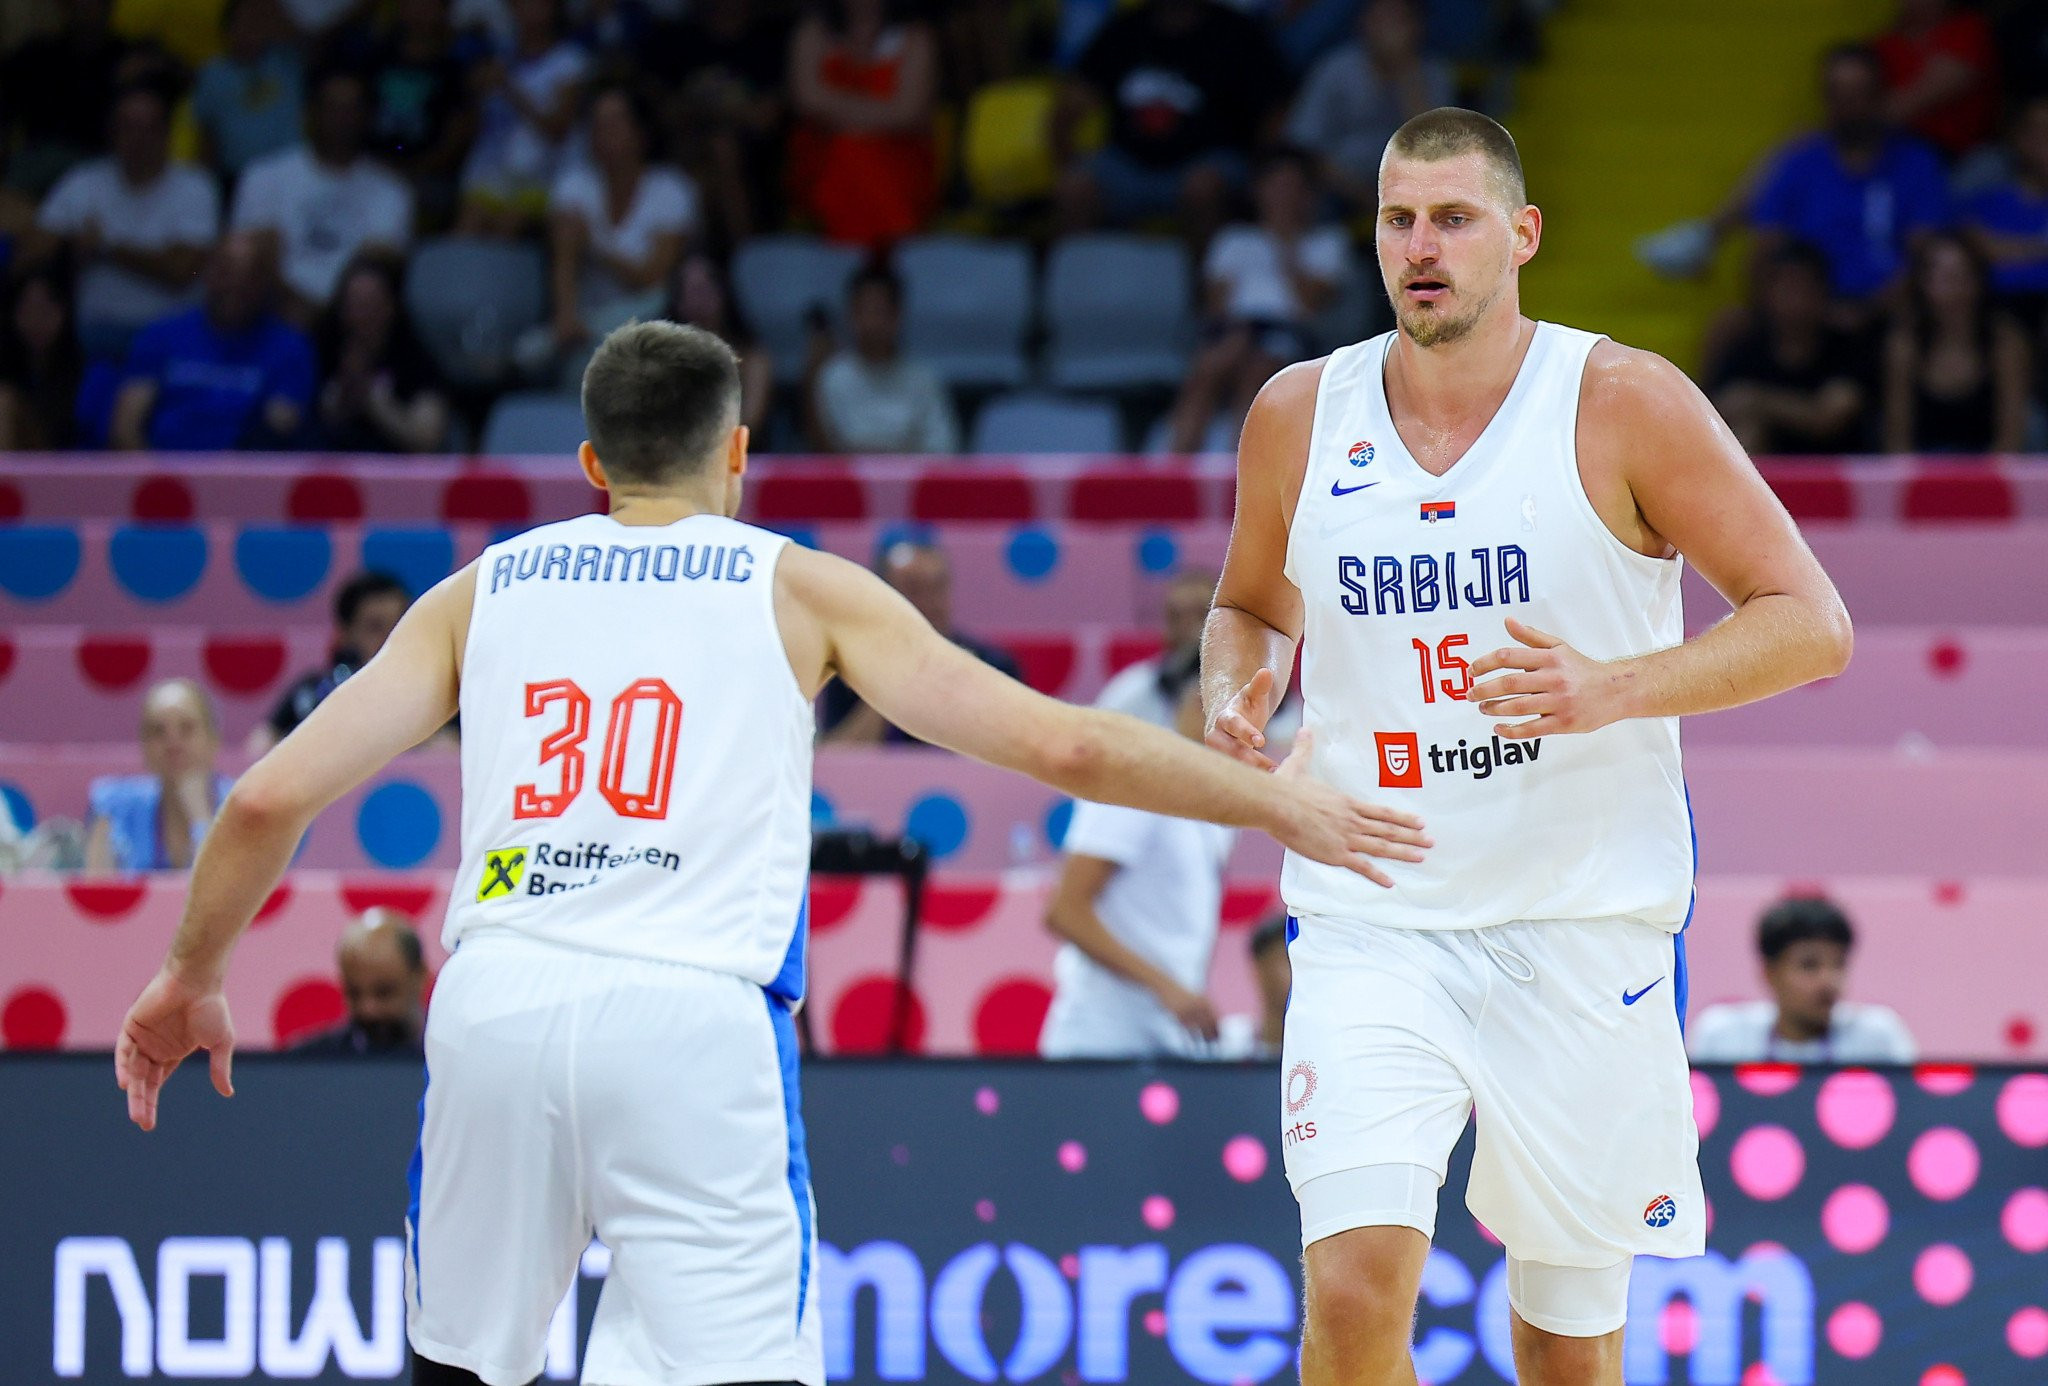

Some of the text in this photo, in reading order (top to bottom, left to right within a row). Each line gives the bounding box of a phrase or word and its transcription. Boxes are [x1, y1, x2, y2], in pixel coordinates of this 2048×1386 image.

[490, 544, 754, 594] AVRAMOVIĆ
[1339, 544, 1531, 616] SRBIJA
[1411, 633, 1475, 703] 15
[513, 677, 683, 821] 30
[1428, 734, 1542, 780] triglav
[1284, 1121, 1317, 1150] mts
